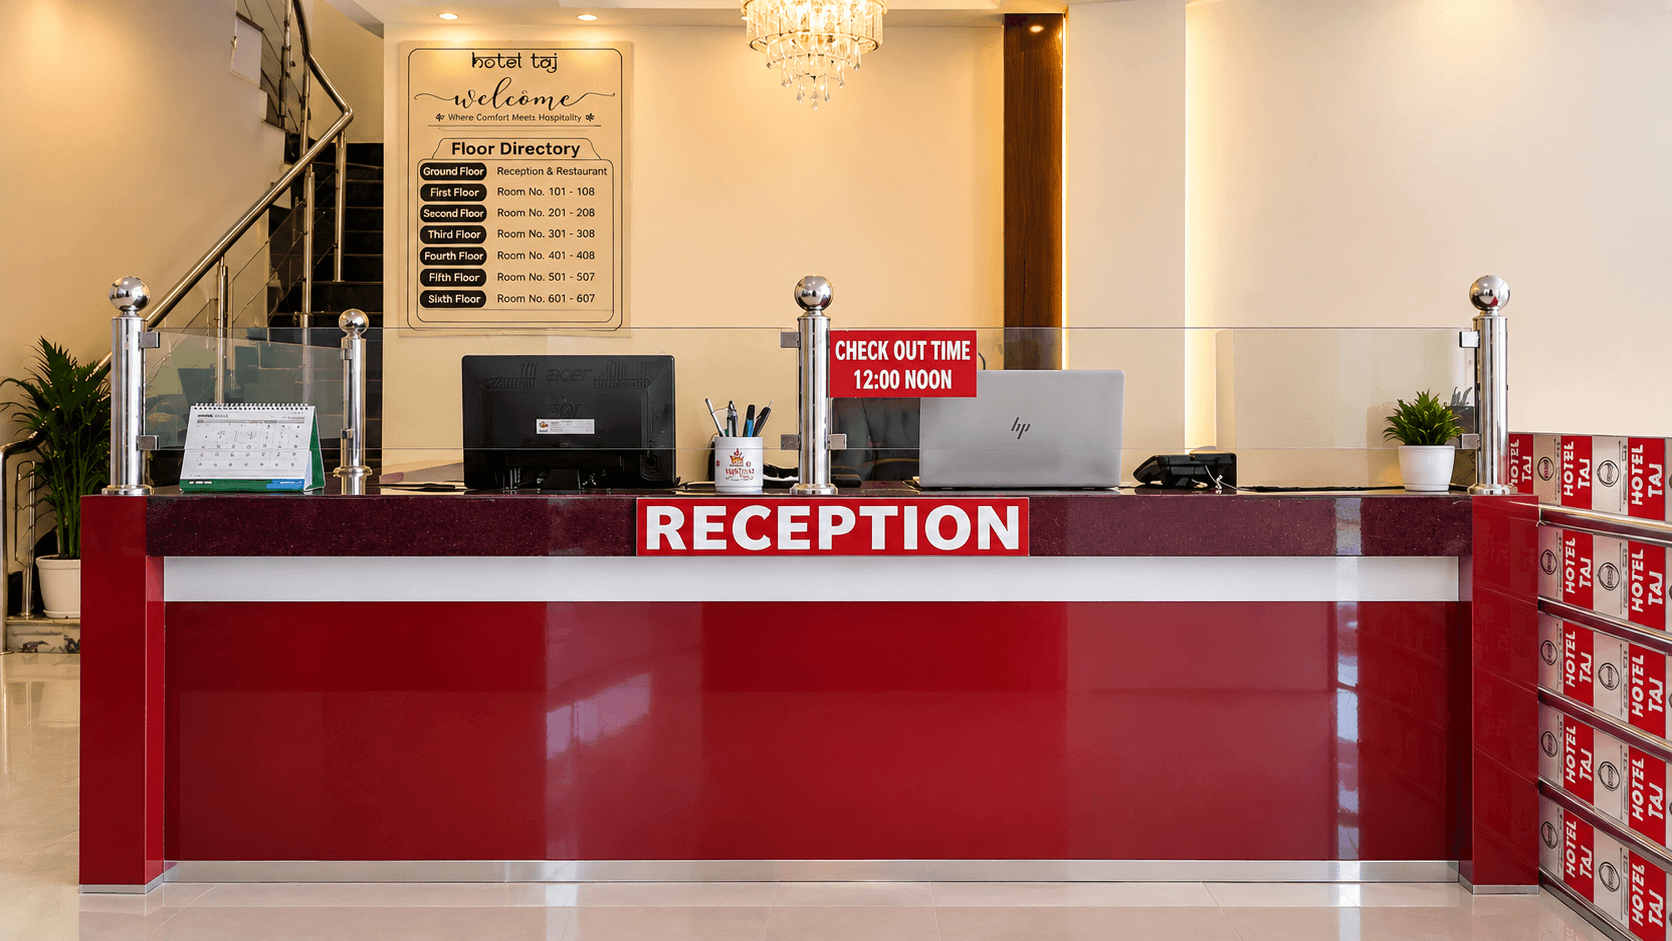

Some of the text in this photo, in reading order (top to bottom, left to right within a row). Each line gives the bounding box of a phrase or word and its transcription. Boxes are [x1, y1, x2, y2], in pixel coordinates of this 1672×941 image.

[472, 52, 558, 74] hotel taj
[414, 76, 616, 111] welcome
[448, 113, 582, 124] Where Comfort Meets Hospitality
[451, 141, 581, 159] Floor Directory
[423, 167, 485, 176] Ground Floor
[497, 166, 608, 178] Reception & Restaurant
[430, 188, 480, 197] First Floor
[497, 187, 526, 197] Room
[528, 187, 546, 197] No.
[548, 187, 566, 197] 101
[576, 187, 596, 197] 108
[423, 208, 485, 218] Second Floor
[497, 207, 526, 217] Room
[528, 207, 546, 217] No.
[548, 207, 566, 217] 201
[576, 207, 596, 217] 208
[428, 229, 481, 239] Third Floor
[497, 229, 526, 239] Room
[528, 229, 546, 239] No.
[548, 229, 566, 239] 301
[576, 229, 596, 239] 308
[424, 251, 484, 261] Fourth Floor
[497, 250, 526, 260] Room
[528, 250, 546, 260] No.
[548, 250, 566, 260] 401
[576, 250, 596, 260] 408
[454, 272, 481, 282] Floor
[497, 272, 526, 282] Room
[528, 272, 546, 282] No.
[548, 272, 566, 282] 501
[576, 272, 596, 282] 507
[455, 294, 482, 304] Floor
[497, 294, 526, 304] Room
[528, 294, 546, 304] No.
[548, 294, 566, 304] 601
[576, 294, 596, 304] 607
[835, 340, 971, 361] CHECK OUT TIME
[545, 367, 593, 383] acer
[853, 369, 952, 390] 12:00 NOON
[1011, 416, 1031, 440] hp
[1521, 455, 1532, 482] TAJ
[1563, 441, 1574, 496] HOTEL
[1577, 458, 1590, 489] TAJ
[1631, 444, 1644, 506] HOTEL
[1647, 463, 1663, 498] TAJ
[646, 504, 1020, 551] RECEPTION
[1565, 537, 1576, 593] HOTEL
[1579, 556, 1592, 588] TAJ
[1631, 549, 1644, 612] HOTEL
[1648, 571, 1663, 606] TAJ
[1565, 631, 1576, 687] HOTEL
[1579, 652, 1592, 683] TAJ
[1631, 655, 1644, 718] HOTEL
[1648, 677, 1663, 713] TAJ
[1565, 725, 1576, 783] HOTEL
[1579, 747, 1592, 781] TAJ
[1631, 757, 1644, 821] HOTEL
[1648, 782, 1663, 819] TAJ
[1565, 820, 1576, 877] HOTEL
[1579, 844, 1592, 879] TAJ
[1631, 863, 1644, 926] HOTEL
[1648, 889, 1663, 927] TAJ
